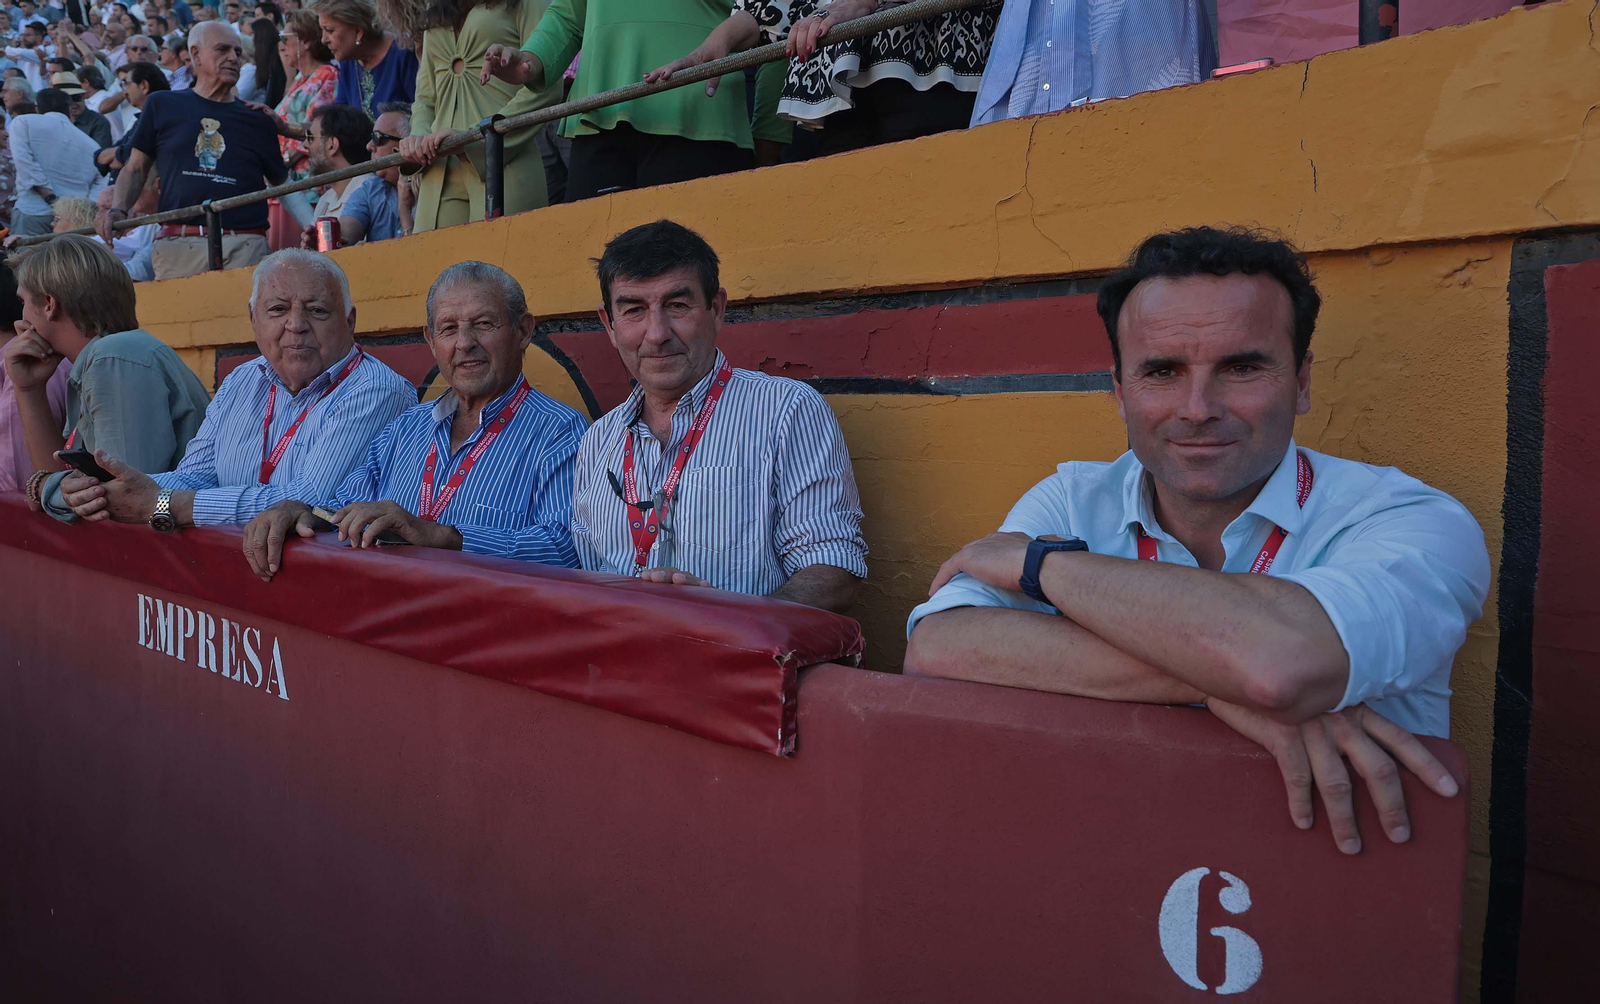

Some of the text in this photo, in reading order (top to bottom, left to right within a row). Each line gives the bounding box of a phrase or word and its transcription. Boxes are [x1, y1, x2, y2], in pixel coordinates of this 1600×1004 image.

[663, 466, 677, 490] CARMELO
[430, 486, 452, 517] ESPECTÁCULOS
[432, 486, 457, 521] CARMELO GARCÍA
[137, 593, 289, 700] EMPRESA
[1158, 866, 1263, 995] 6
